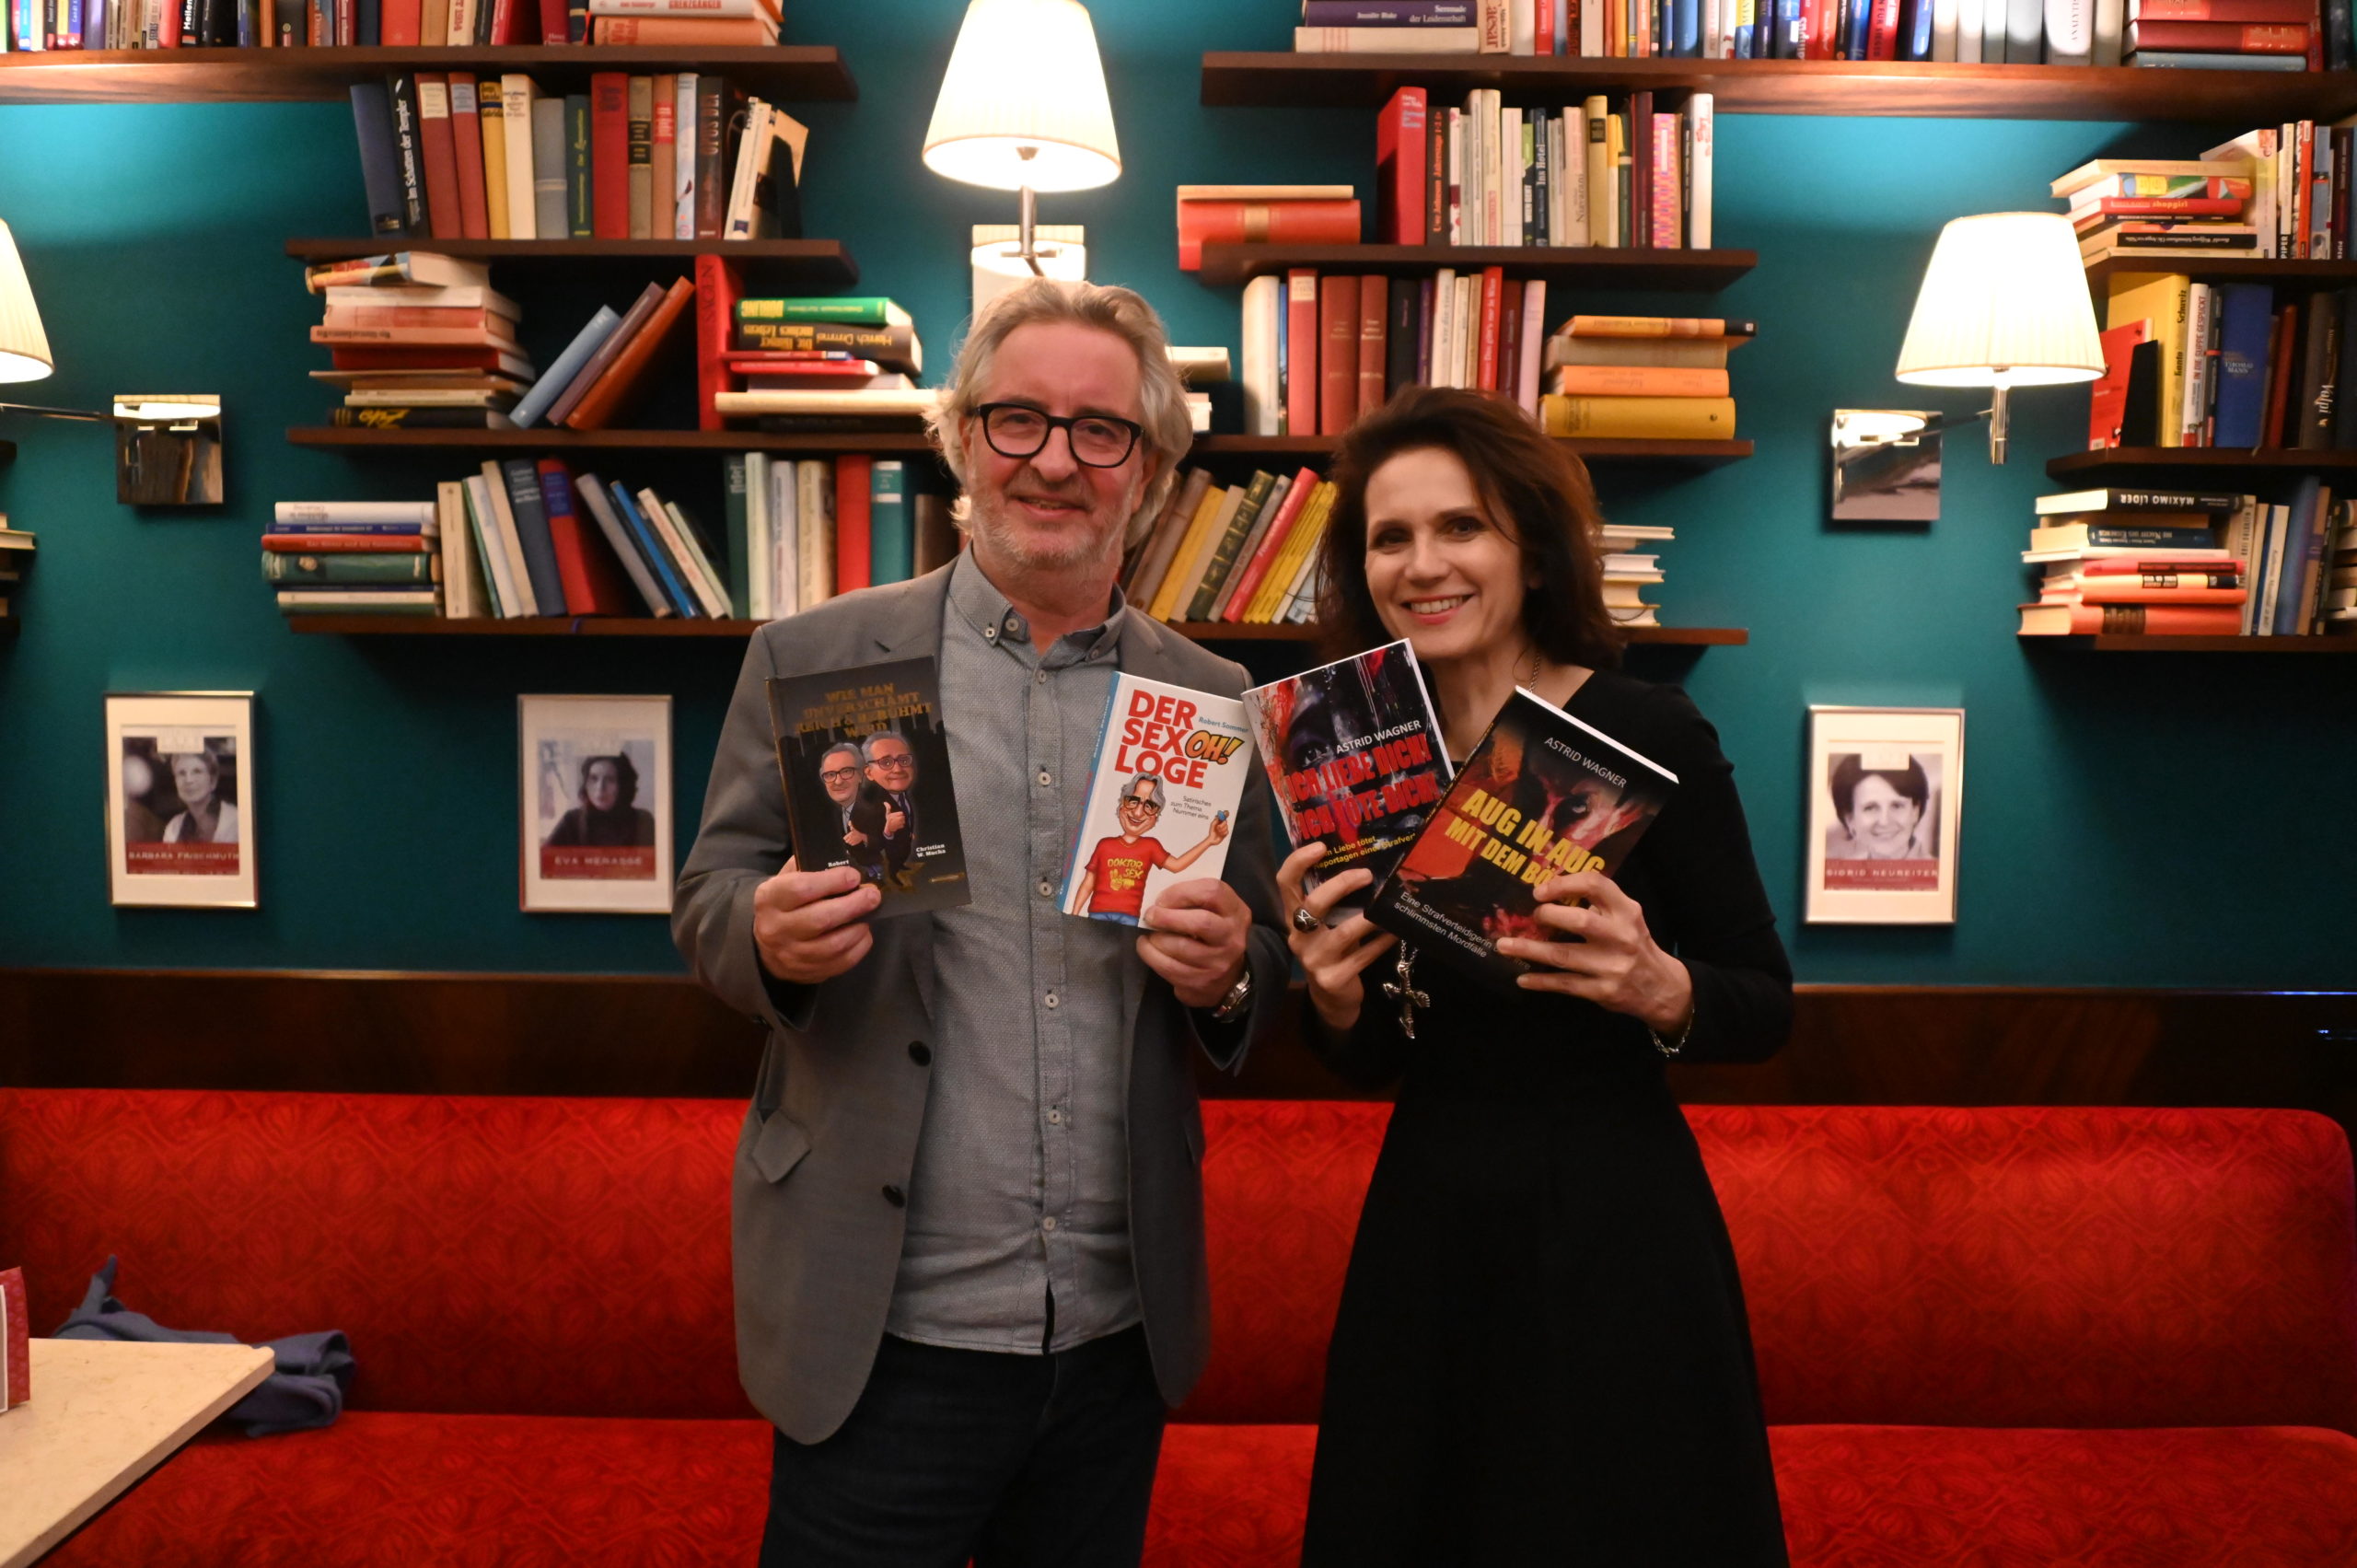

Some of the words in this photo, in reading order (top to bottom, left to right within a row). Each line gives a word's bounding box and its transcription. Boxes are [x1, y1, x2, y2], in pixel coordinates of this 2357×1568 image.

[1410, 14, 1422, 23] der
[1422, 14, 1467, 24] Leidenschaft
[1434, 4, 1467, 14] Serenade
[700, 93, 720, 118] DEI
[400, 134, 412, 149] der
[700, 122, 720, 157] OPUS
[1536, 144, 1547, 169] Hotel
[1575, 174, 1585, 224] Niavarani
[2152, 200, 2189, 209] shopgirl
[2280, 236, 2288, 260] PIPER
[2316, 384, 2336, 413] Volpi
[2120, 494, 2149, 506] LÍDER
[2152, 494, 2195, 506] MÁXIMO
[826, 689, 857, 703] WIE
[861, 683, 895, 696] MAN
[1128, 689, 1198, 730] DER
[1198, 716, 1222, 728] Robert
[1221, 721, 1249, 734] Sommer
[1121, 717, 1189, 757] SEX
[1184, 730, 1245, 765] OH!
[1336, 735, 1373, 755] ASTRID
[1374, 720, 1422, 742] WAGNER
[1114, 744, 1209, 789] LOGE
[1285, 767, 1323, 804] ICH
[1321, 751, 1376, 792] LIEBE
[1372, 733, 1433, 777] DICH!
[1544, 737, 1582, 763] ASTRID
[1582, 759, 1628, 789] WAGNER
[1170, 801, 1183, 809] zum
[1183, 802, 1203, 813] Thema
[1182, 796, 1213, 807] Satirisches
[1295, 804, 1336, 840] ICH
[1331, 789, 1384, 833] TÖTE
[1381, 772, 1441, 815] DICH!
[1173, 807, 1198, 819] Nummer
[1197, 812, 1210, 820] eins
[1460, 788, 1522, 838] AUG
[1515, 819, 1555, 855] IN
[1546, 836, 1607, 874] AUG
[916, 842, 946, 853] Christian
[926, 848, 946, 857] Mucha
[1334, 842, 1357, 855] Liebe
[1444, 818, 1488, 852] MIT
[1480, 837, 1529, 876] DEM
[554, 856, 580, 866] EVA
[828, 860, 850, 868] Robert
[1107, 857, 1144, 869] DOKTOR
[1124, 867, 1144, 879] SEX
[1394, 900, 1447, 935] schlimmsten
[1400, 891, 1421, 909] Eine
[1422, 903, 1493, 950] Strafverteidigerin
